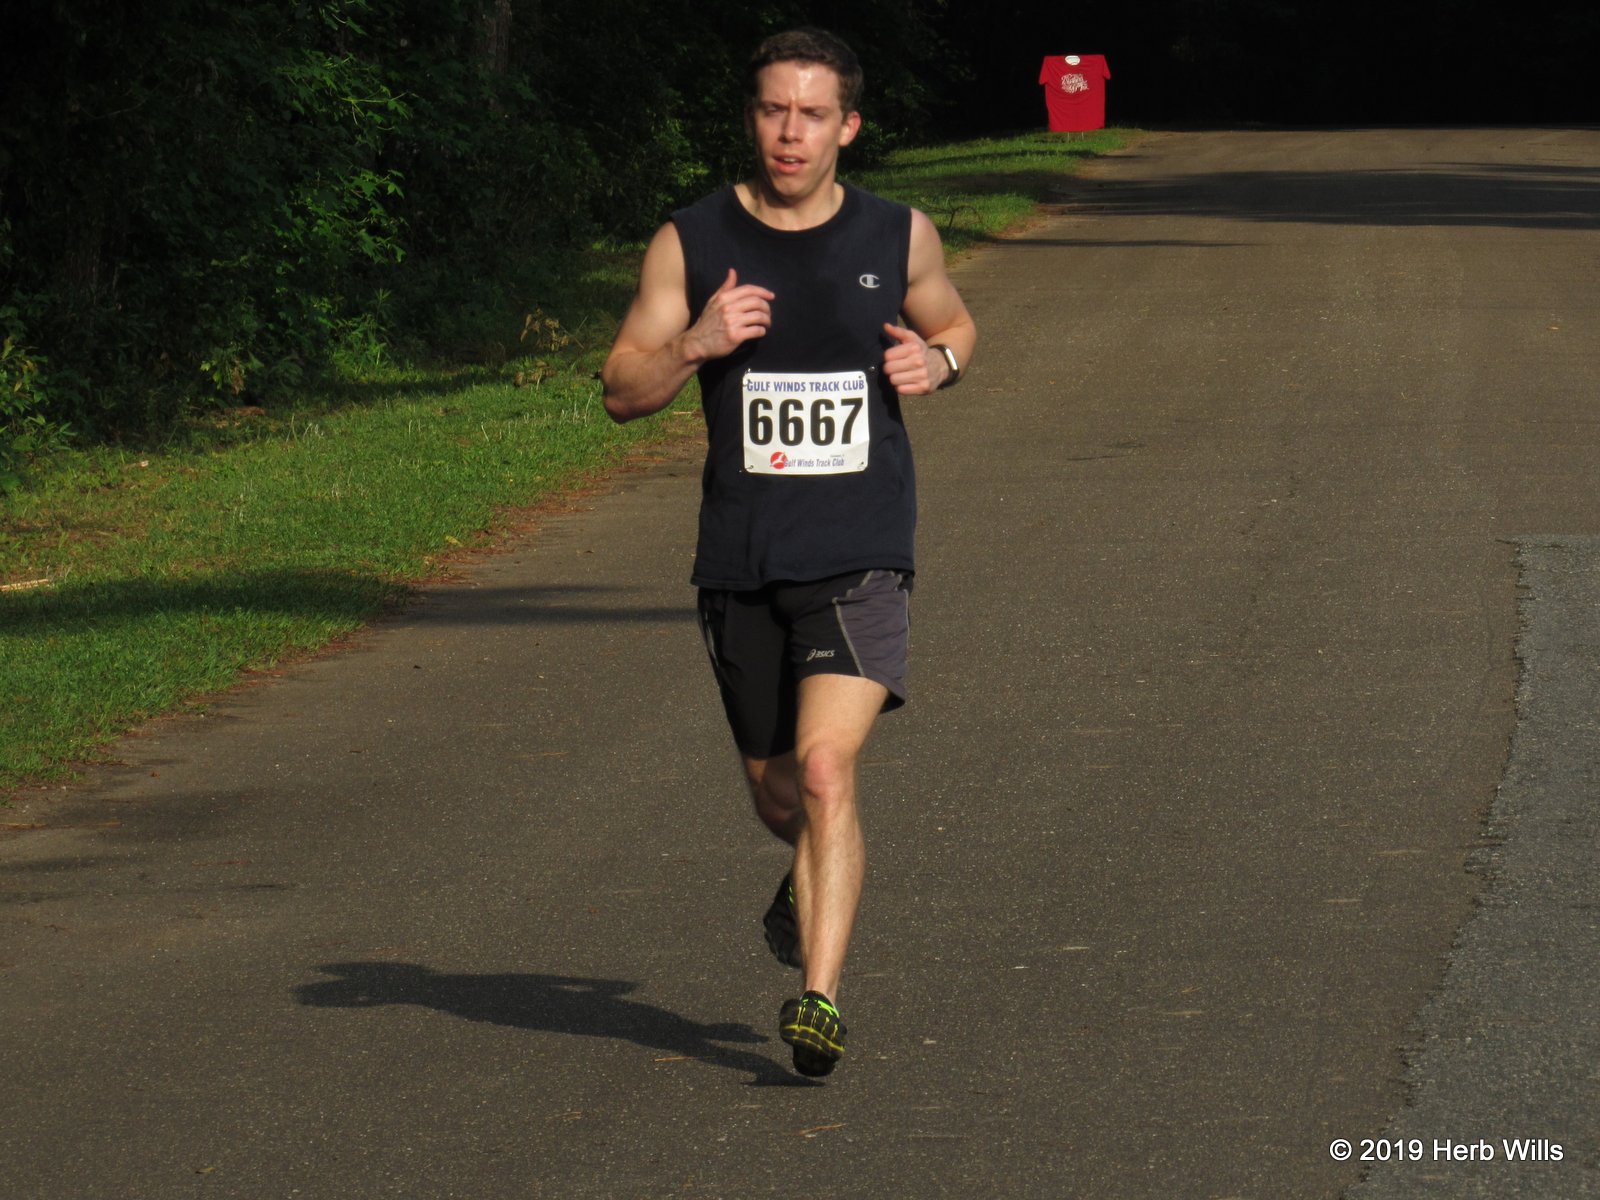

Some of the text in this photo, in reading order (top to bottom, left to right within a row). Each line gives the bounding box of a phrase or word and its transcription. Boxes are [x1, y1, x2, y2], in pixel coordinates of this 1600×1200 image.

[747, 380, 865, 392] GULF WINDS TRACK CLUB
[749, 397, 863, 446] 6667
[797, 459, 814, 467] Winds
[816, 459, 830, 467] Track
[832, 458, 845, 467] Club
